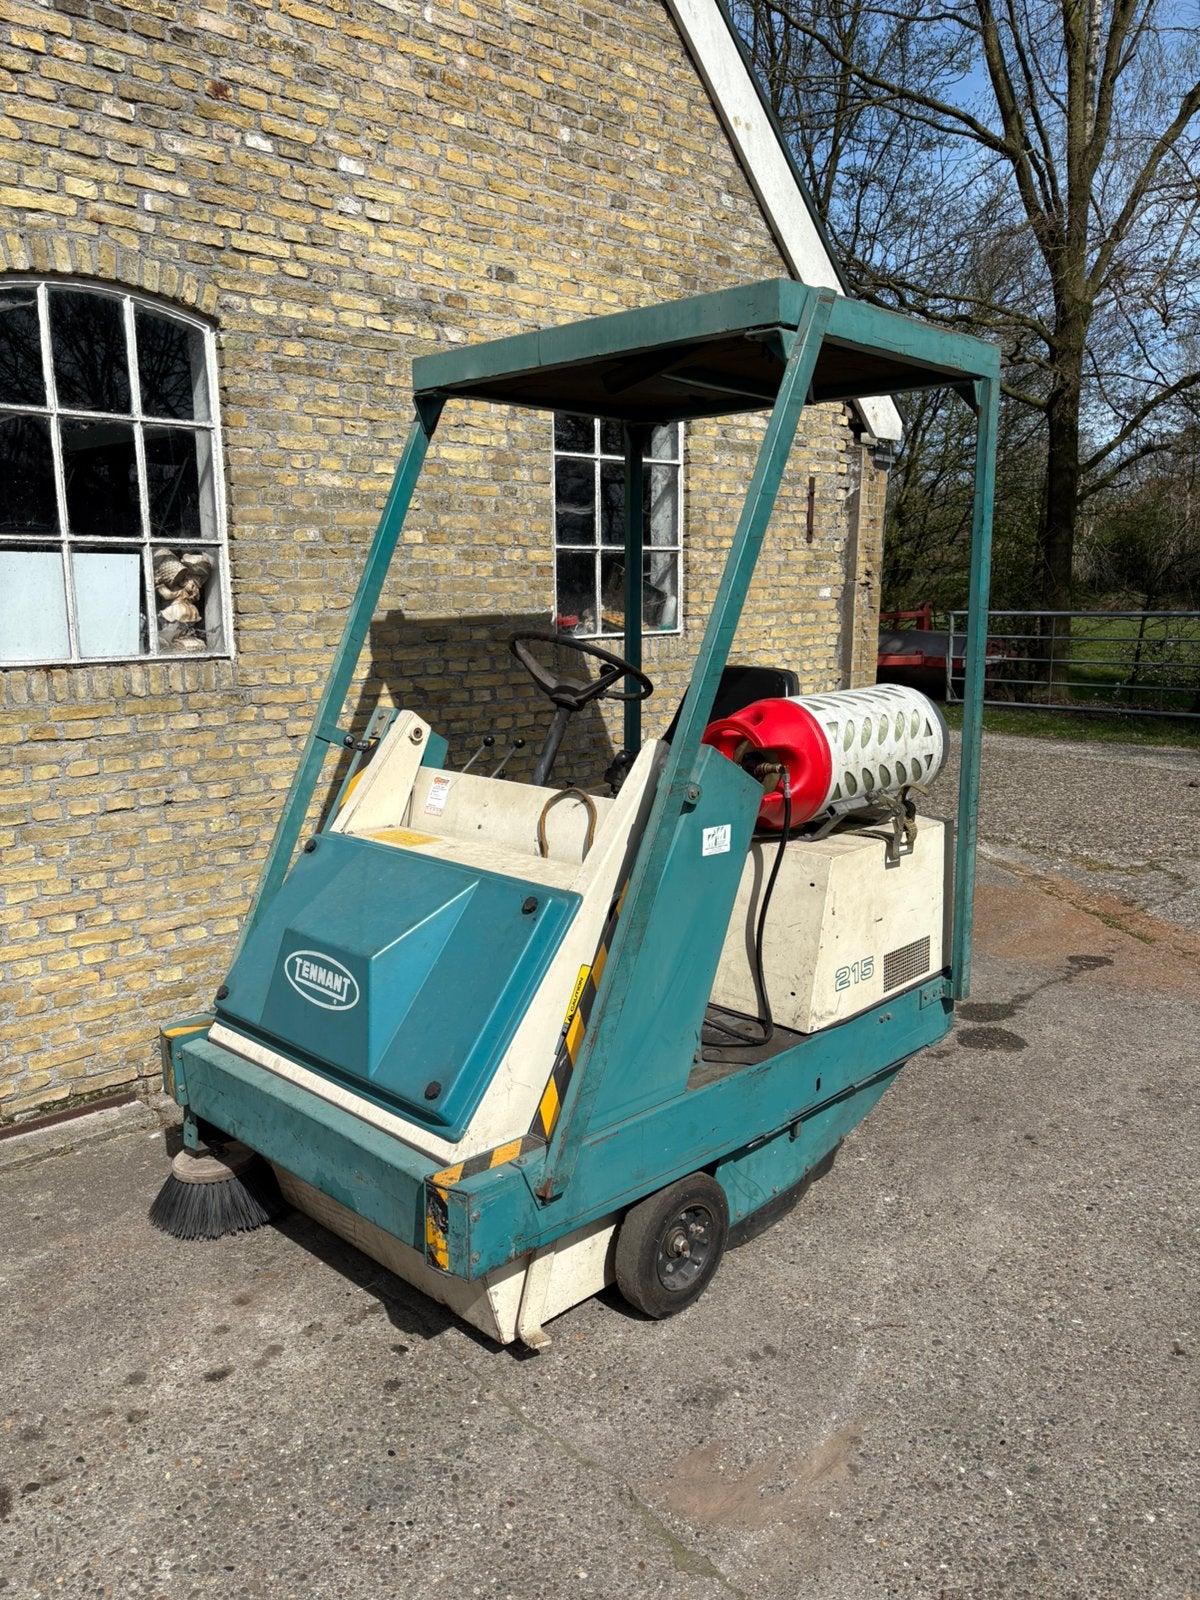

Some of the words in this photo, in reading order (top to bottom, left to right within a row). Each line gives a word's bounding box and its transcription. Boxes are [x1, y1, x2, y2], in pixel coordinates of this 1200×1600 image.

[295, 957, 351, 1002] TENNANT
[835, 955, 875, 992] 215
[570, 976, 584, 1012] CAUTION
